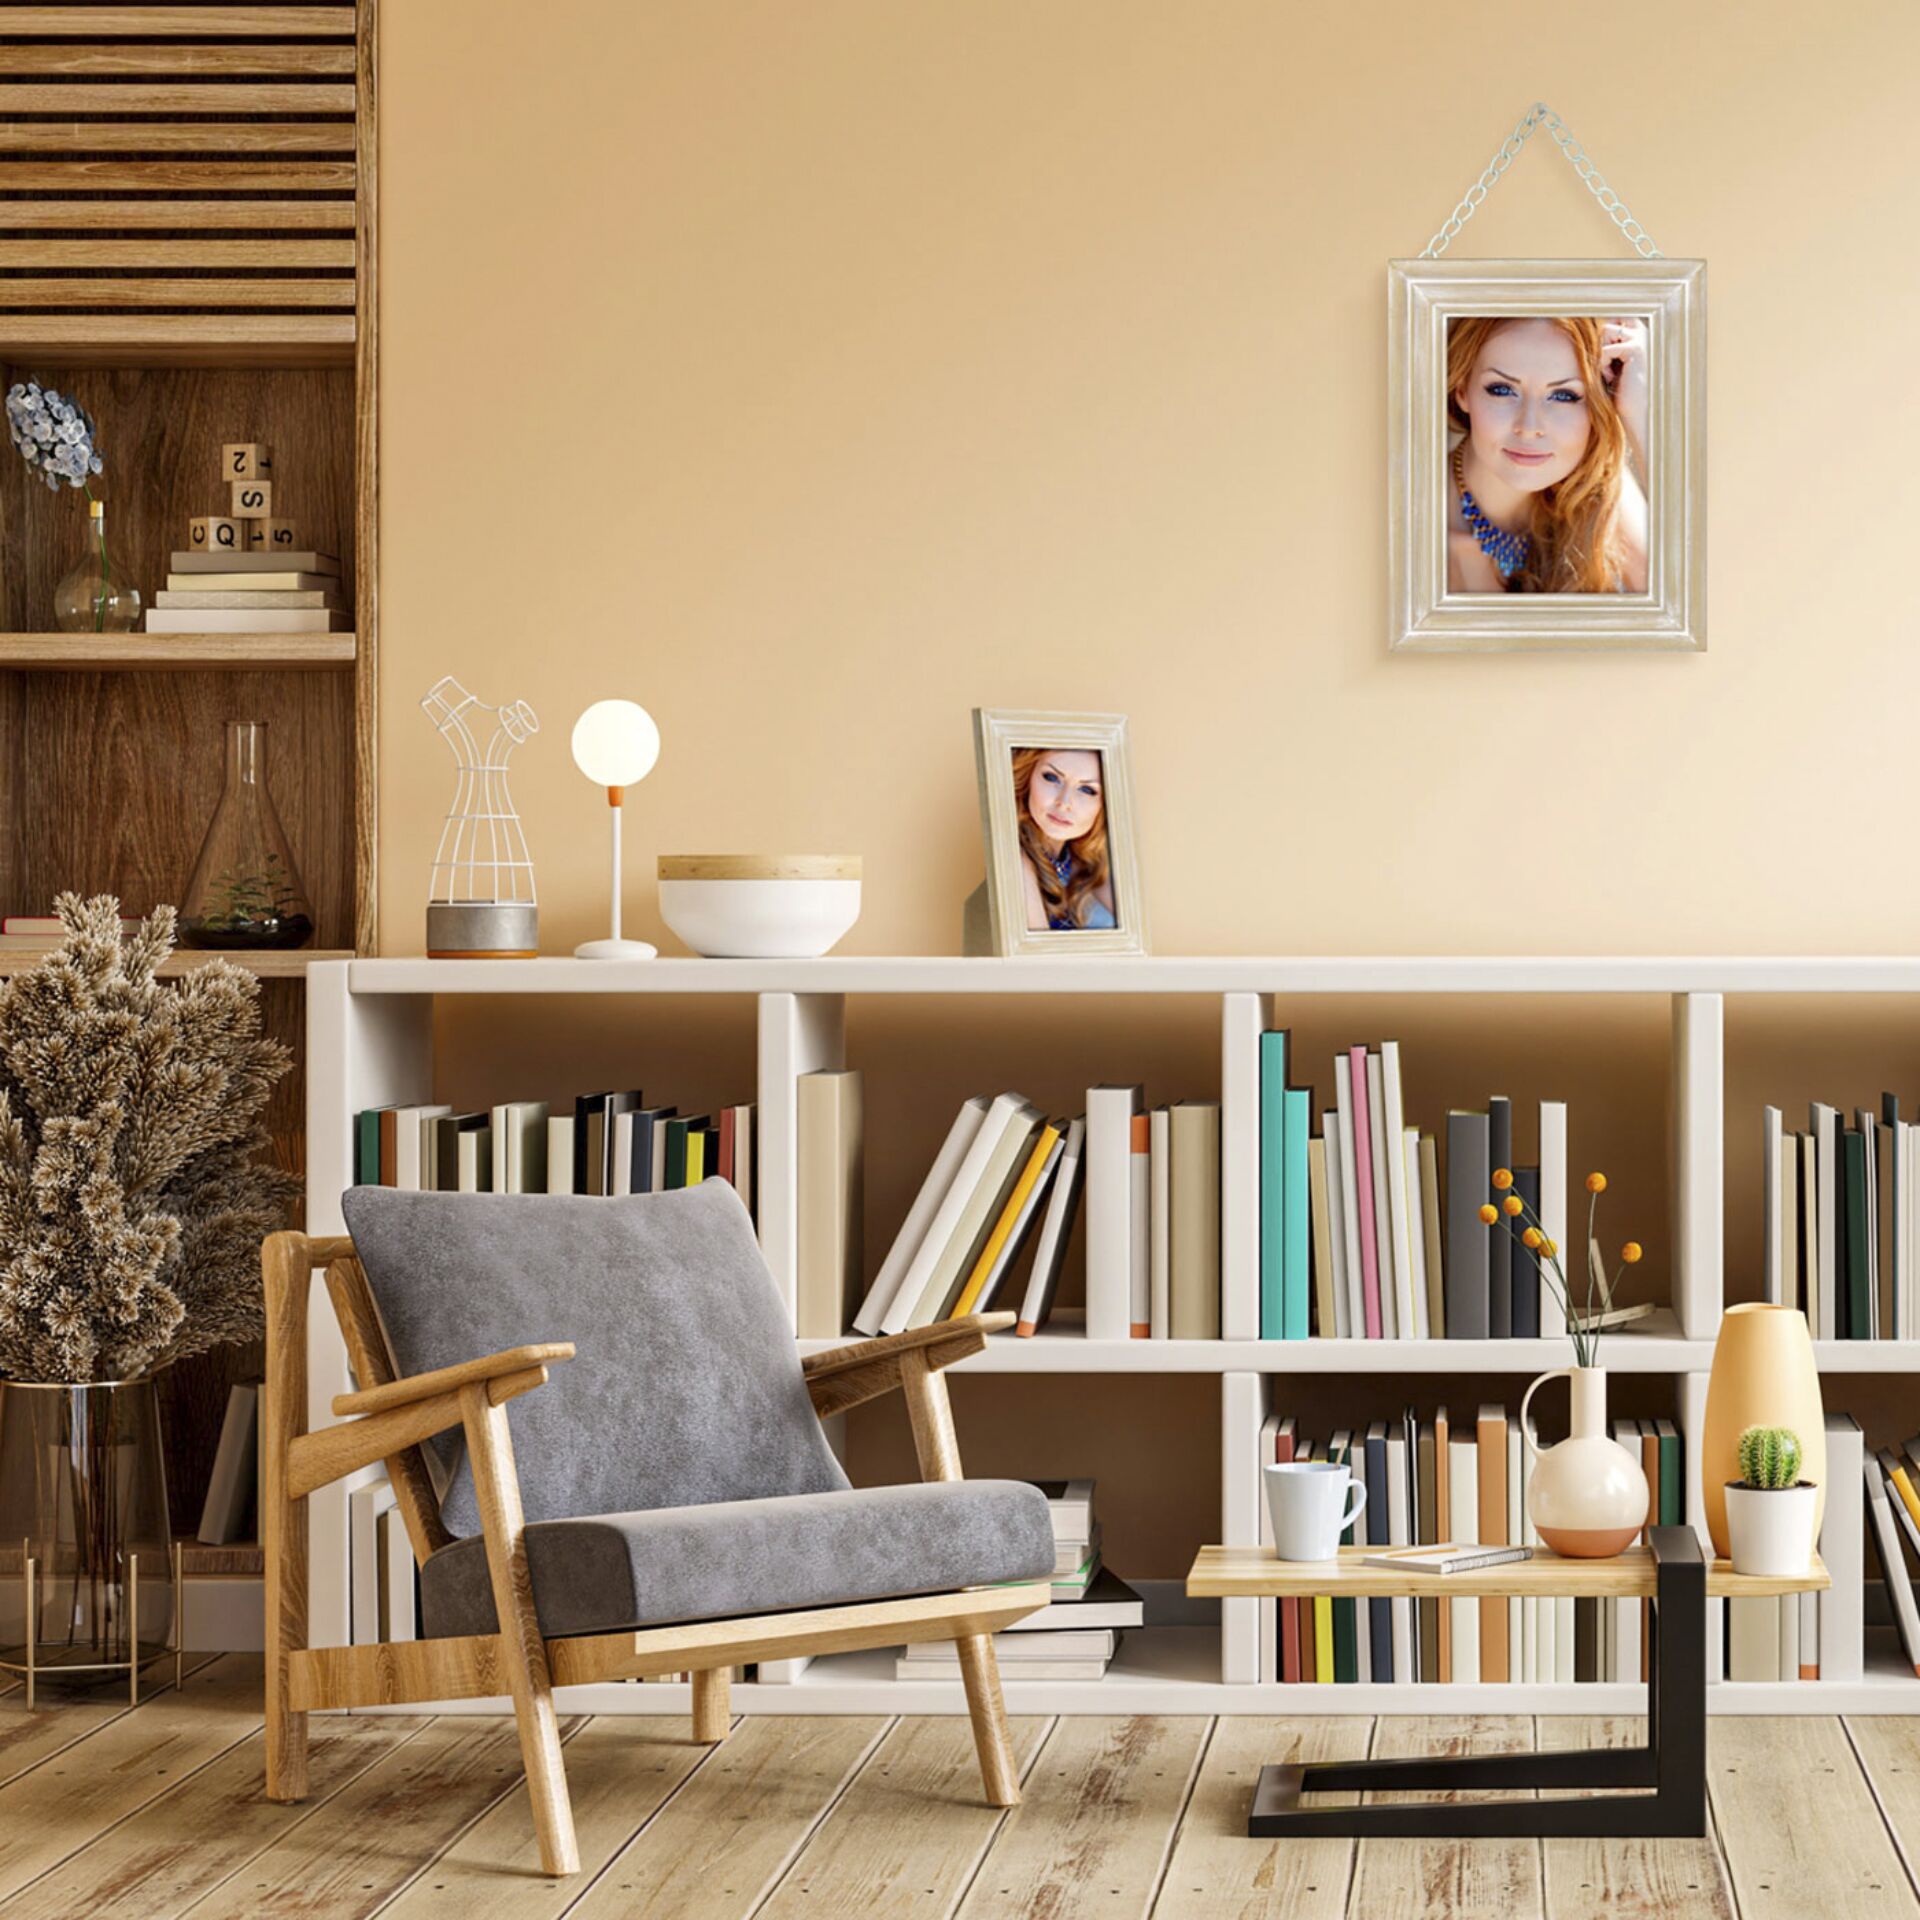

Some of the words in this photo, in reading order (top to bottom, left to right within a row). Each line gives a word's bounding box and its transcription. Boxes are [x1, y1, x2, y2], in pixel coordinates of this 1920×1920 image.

[233, 451, 246, 473] 2
[241, 490, 264, 508] S
[216, 523, 235, 547] Q
[273, 529, 293, 544] 5
